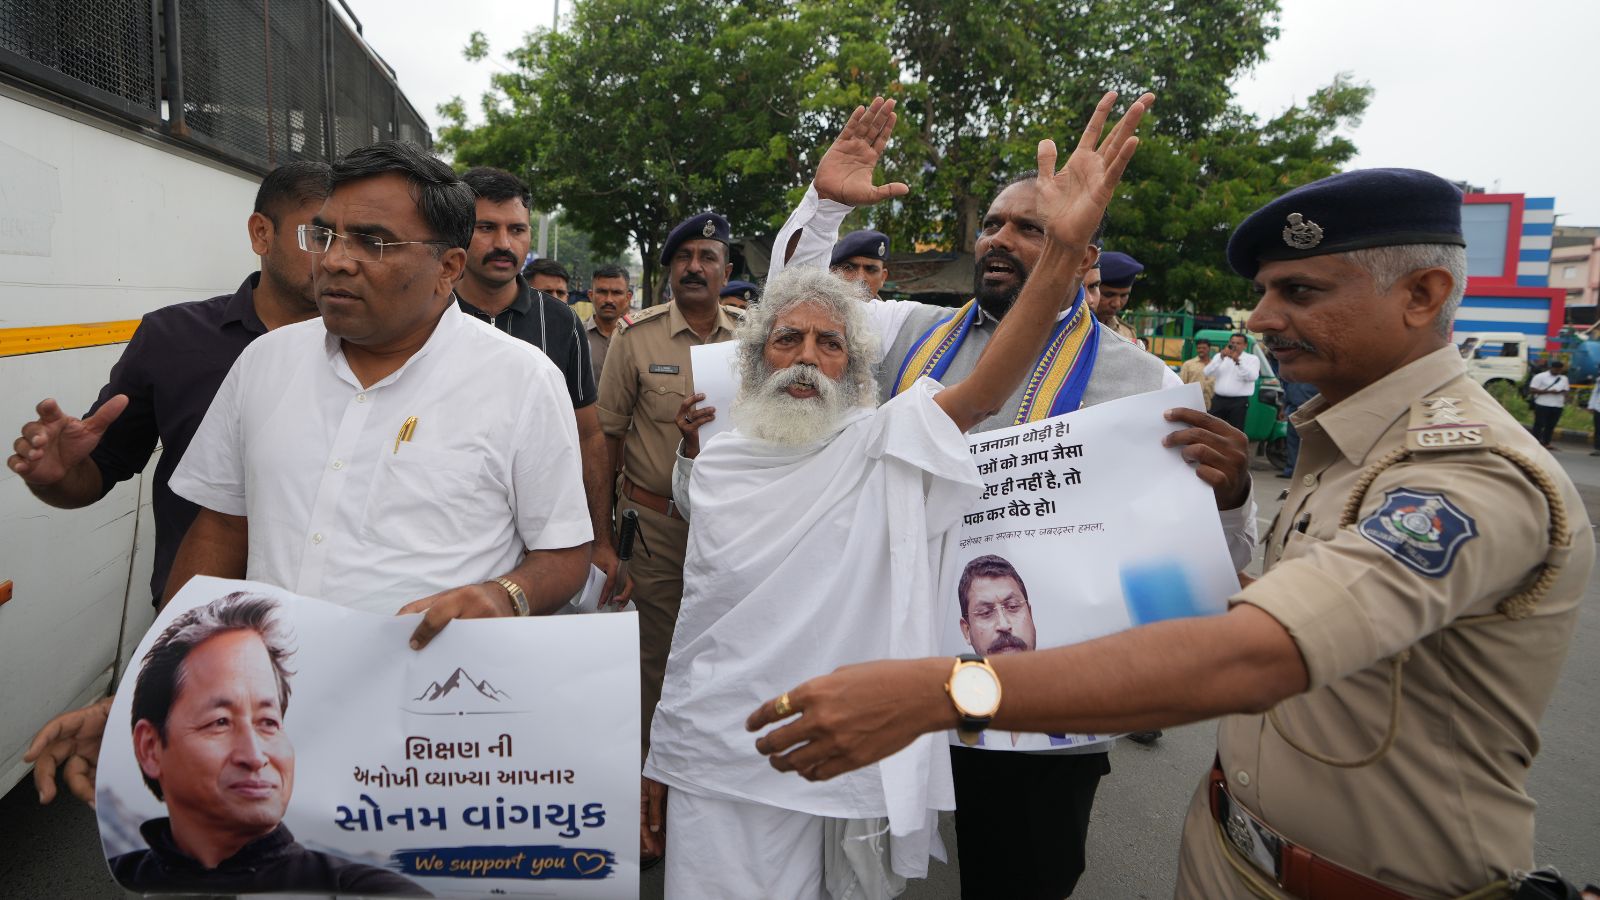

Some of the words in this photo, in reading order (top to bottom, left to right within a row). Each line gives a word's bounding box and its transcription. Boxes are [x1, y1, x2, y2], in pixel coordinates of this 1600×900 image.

[980, 435, 1020, 453] जनाजा
[1023, 425, 1053, 443] थोड़ी
[1417, 428, 1483, 447] GPS
[977, 458, 998, 476] ाओं
[1000, 454, 1018, 470] को
[1021, 450, 1049, 466] आप
[1052, 443, 1083, 460] जैसा
[1001, 477, 1014, 496] ही
[1016, 472, 1044, 491] नहीं
[1044, 469, 1061, 489] है,
[1063, 467, 1081, 485] तो
[961, 511, 984, 528] पक
[986, 506, 1005, 521] कर
[1008, 500, 1031, 517] बैठे
[1034, 497, 1056, 516] हो।
[996, 530, 1021, 540] सरकार
[1024, 529, 1036, 538] पर
[1039, 525, 1074, 536] जबरदस्त
[405, 736, 480, 760] શિક્ષણ
[488, 733, 513, 758] ની
[353, 765, 419, 788] અનોખી
[425, 770, 490, 787] વ્યાખ્યા
[497, 769, 575, 786] આપનાર
[334, 793, 447, 832] સોનમ
[462, 797, 606, 838] વાંગચુક
[415, 854, 444, 871] We
[450, 852, 526, 876] support
[530, 856, 566, 876] you
